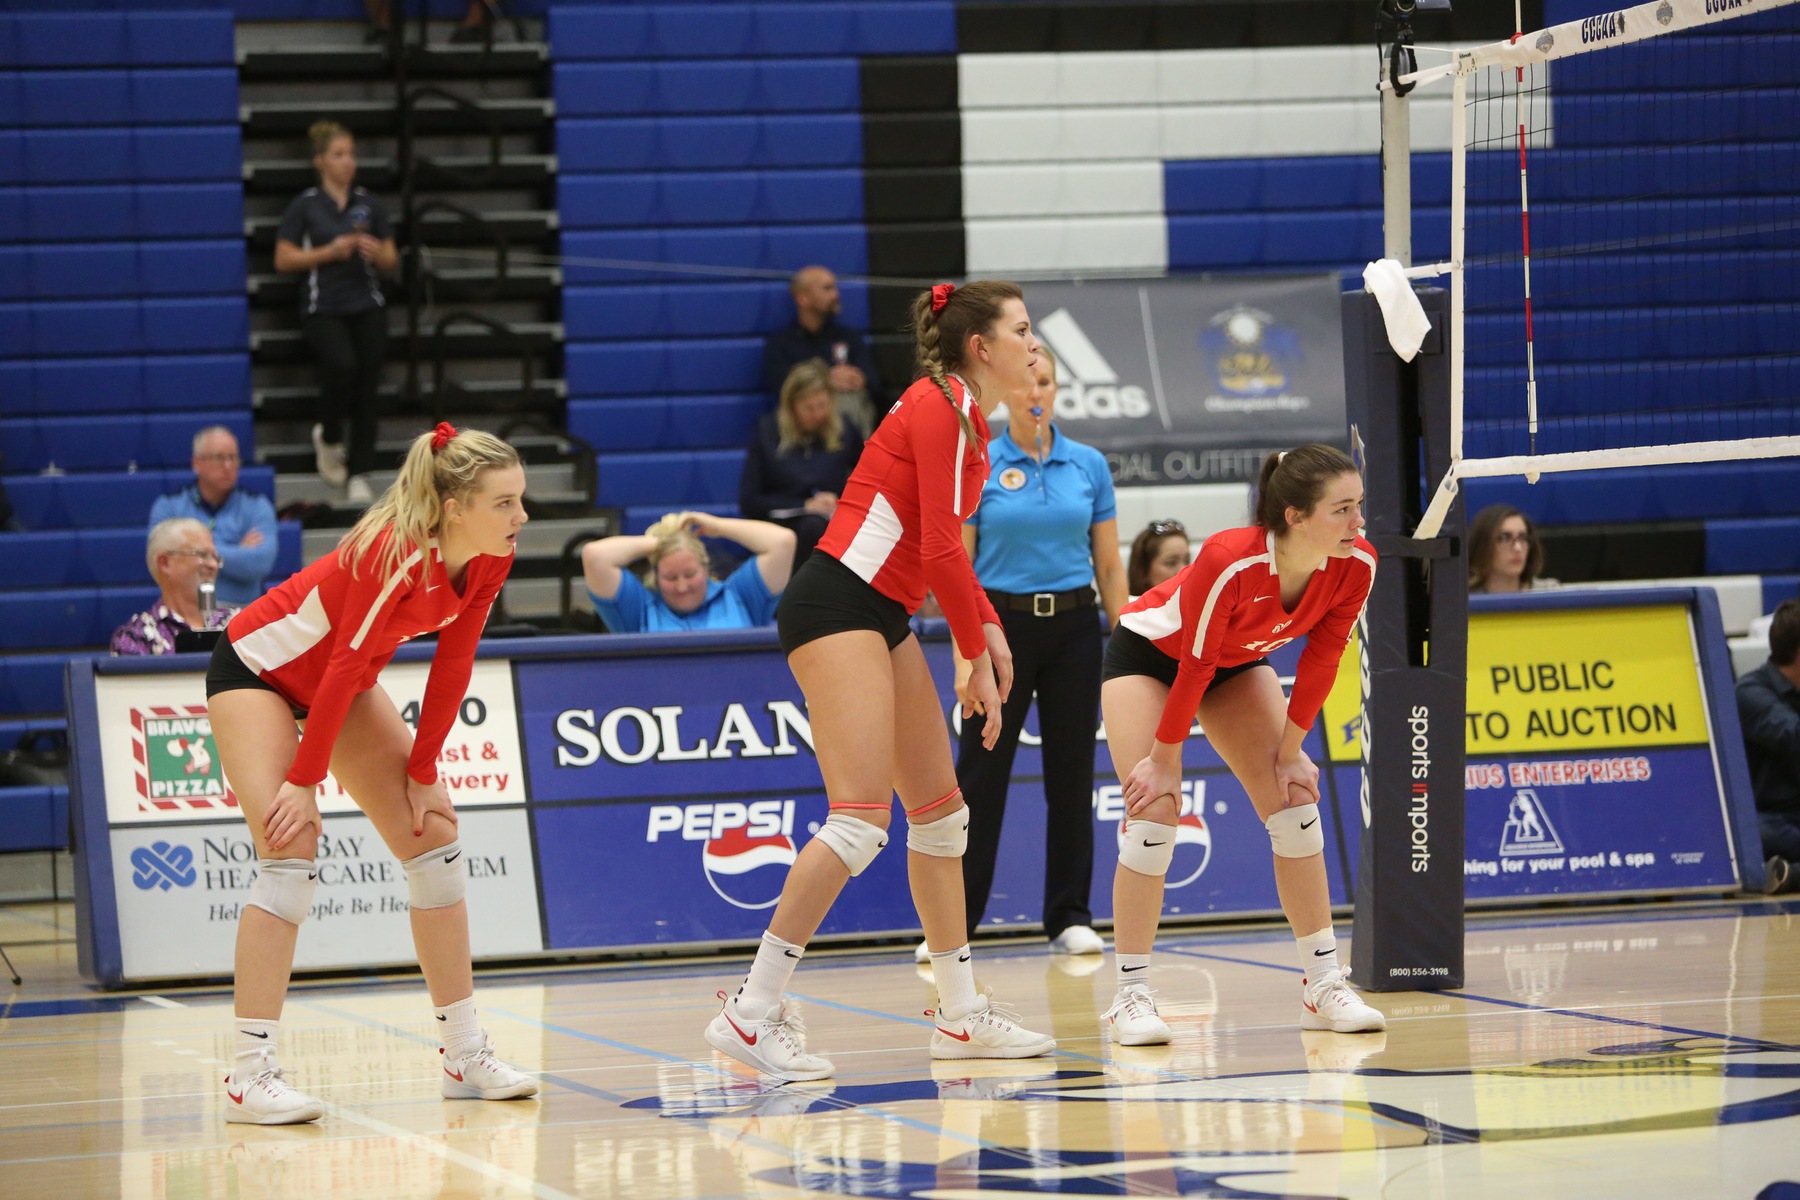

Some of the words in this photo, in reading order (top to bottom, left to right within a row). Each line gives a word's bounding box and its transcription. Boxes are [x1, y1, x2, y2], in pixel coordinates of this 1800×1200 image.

[1491, 660, 1614, 694] PUBLIC
[146, 719, 212, 737] BRAVO
[555, 700, 816, 767] SOLAN
[1466, 711, 1510, 740] TO
[1526, 703, 1677, 738] AUCTION
[481, 741, 498, 760] &
[1407, 705, 1431, 779] sports
[1508, 757, 1652, 787] ENTERPRISES
[152, 779, 223, 797] PIZZA
[646, 800, 796, 843] PEPSI
[1501, 857, 1525, 873] for
[1529, 857, 1565, 874] your
[1569, 852, 1605, 872] pool
[1609, 851, 1622, 867] &
[1625, 852, 1655, 868] spa
[351, 896, 374, 914] Be
[1390, 967, 1411, 977] (800)
[1412, 967, 1449, 976] 556-3198
